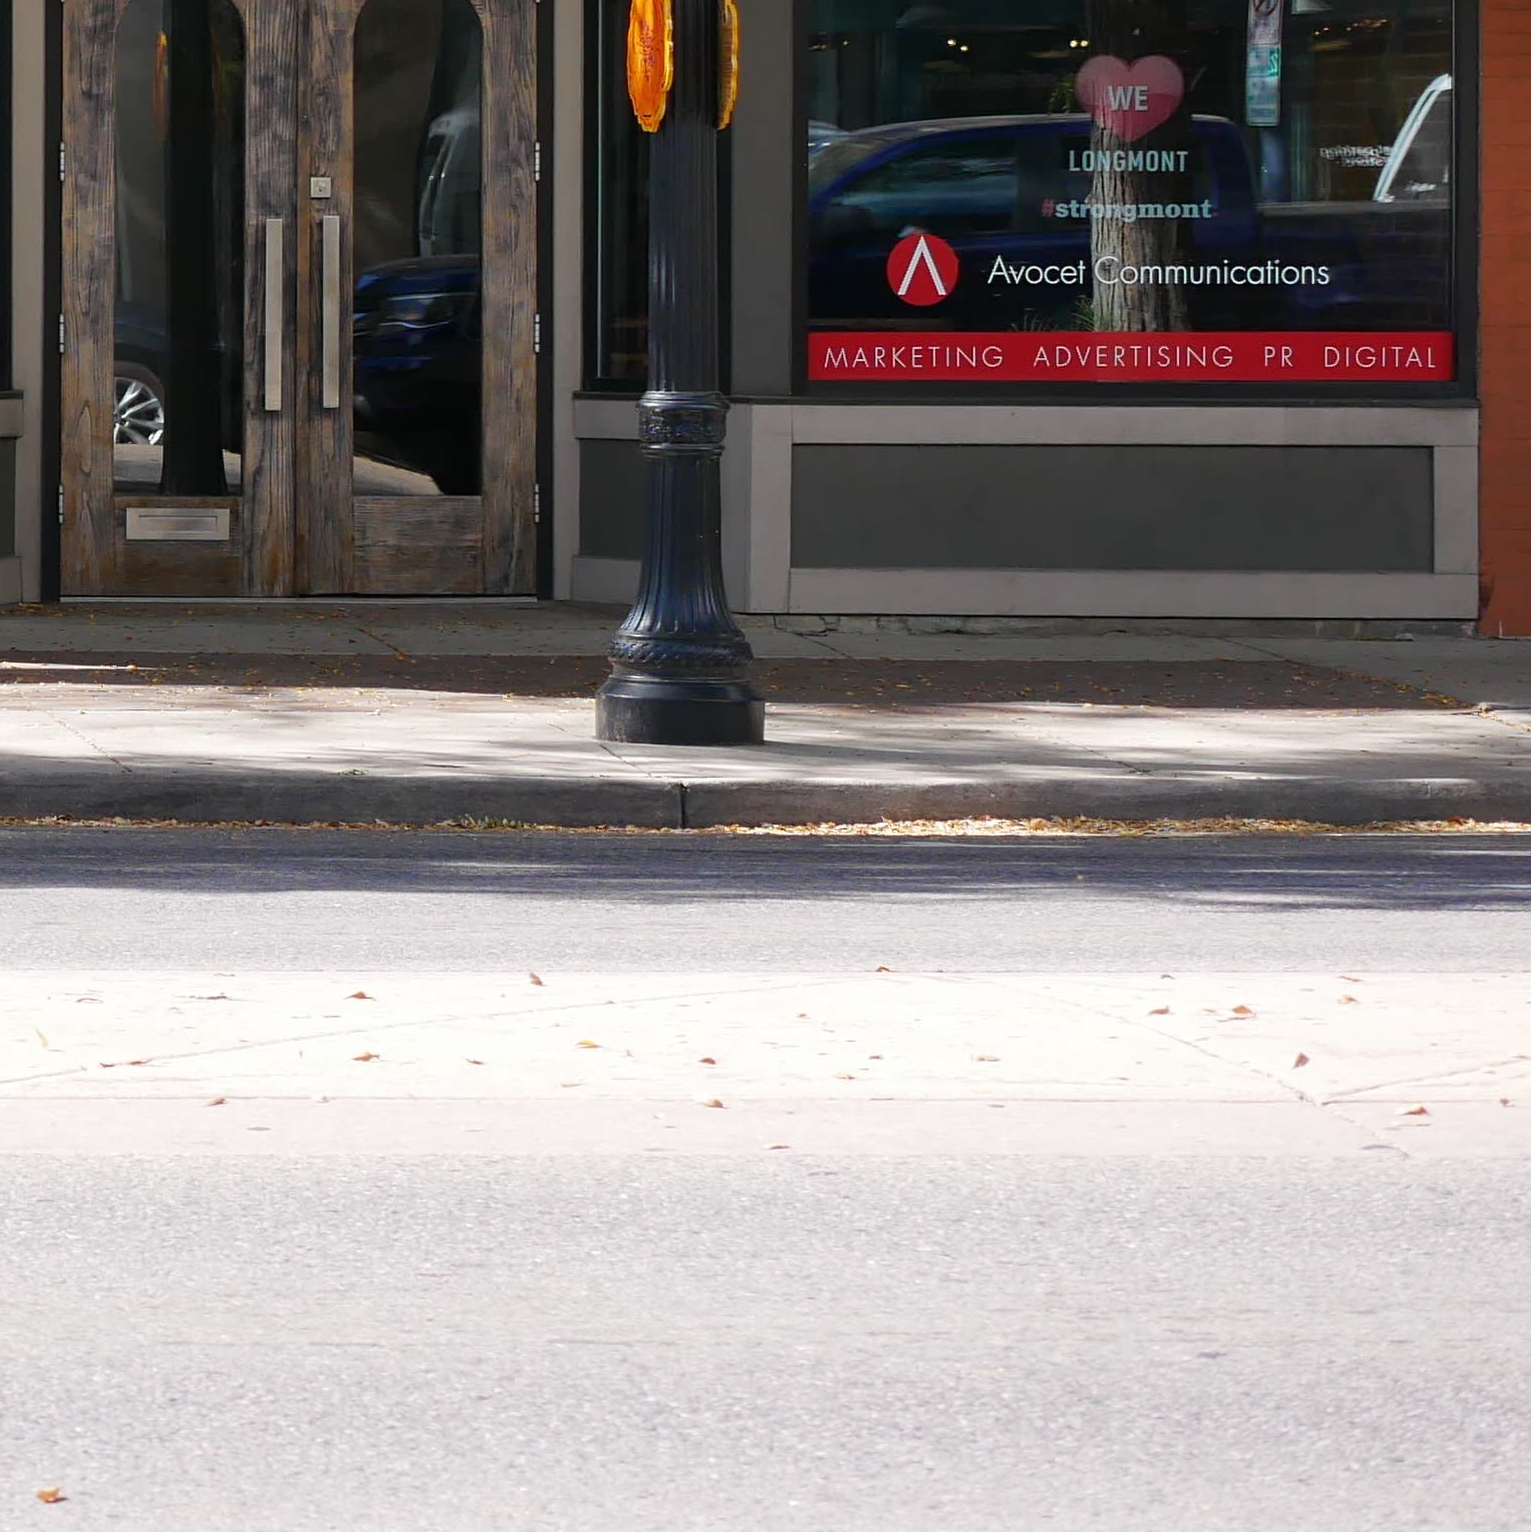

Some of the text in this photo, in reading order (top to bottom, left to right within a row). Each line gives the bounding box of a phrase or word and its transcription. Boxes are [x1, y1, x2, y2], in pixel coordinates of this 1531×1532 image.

[1107, 85, 1148, 111] WE
[1069, 150, 1189, 172] LONGMONT
[988, 255, 1330, 286] Avocet Communications
[824, 345, 1436, 368] MARKETING ADVERTISING PR DIGITAL
